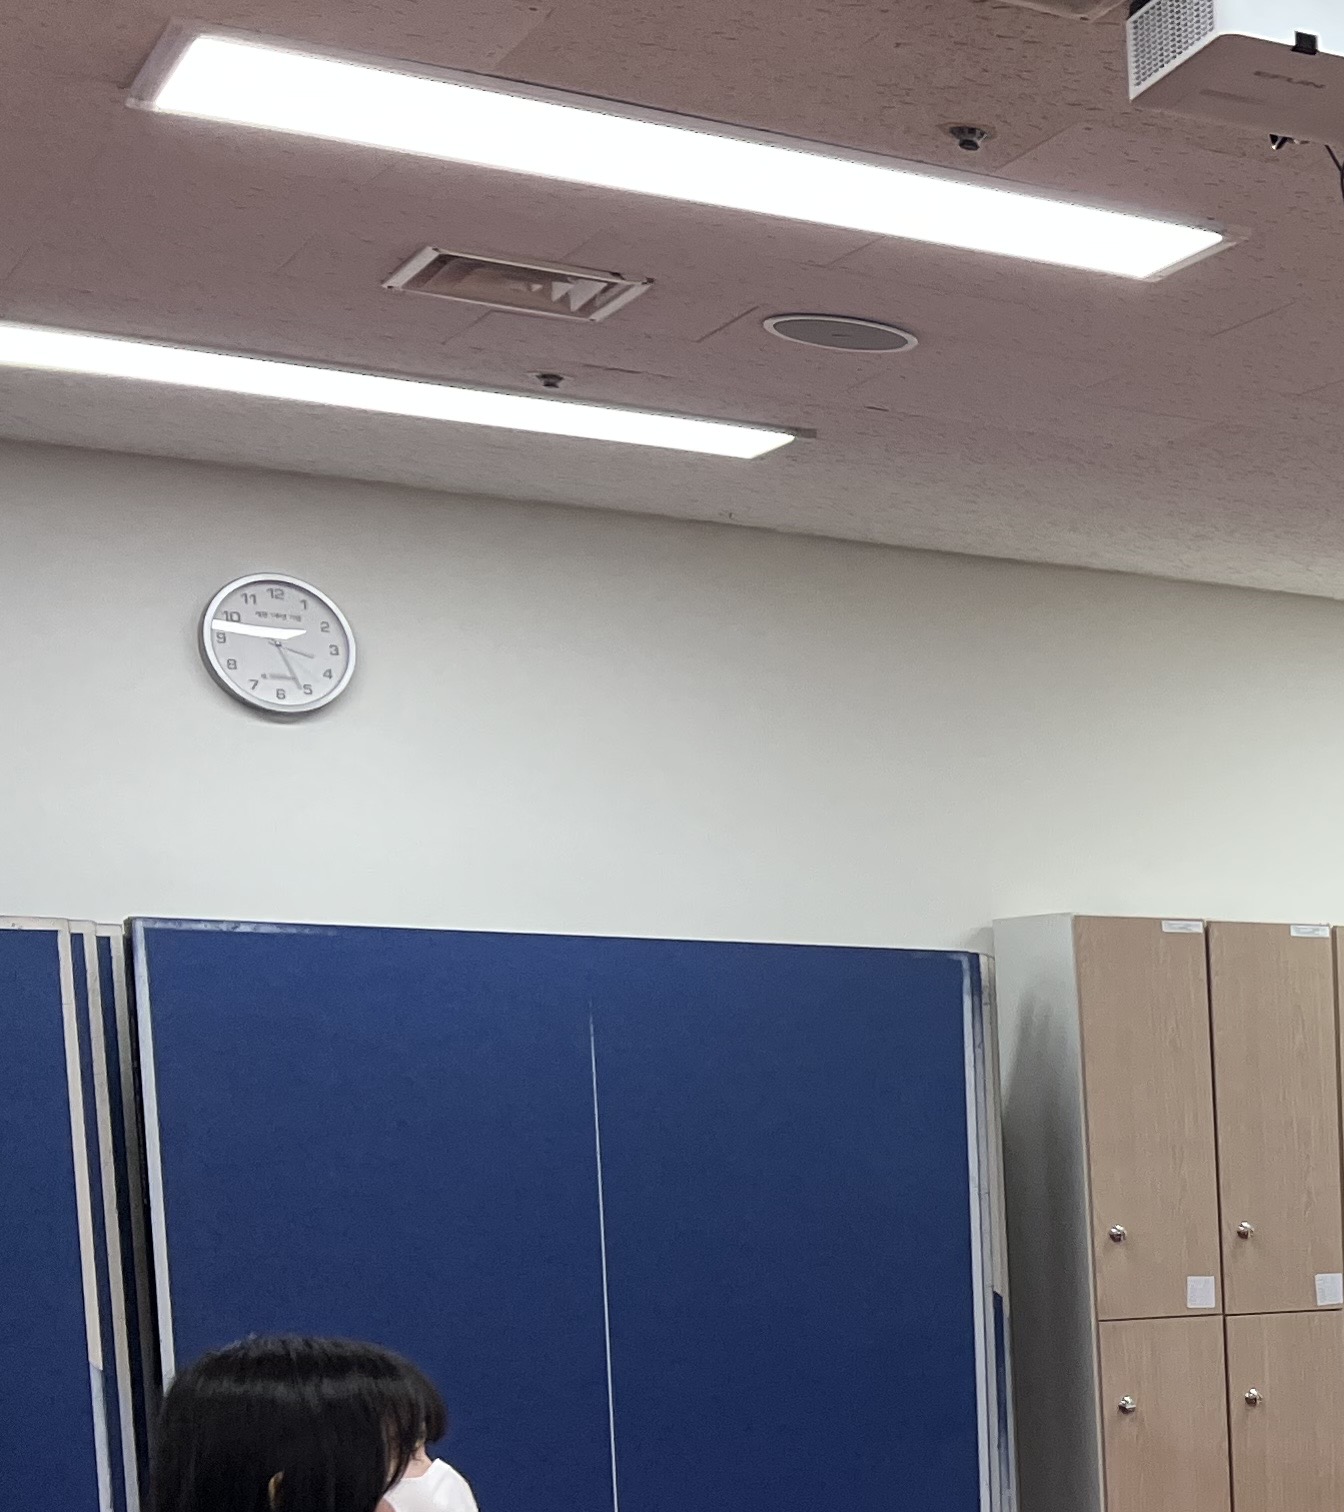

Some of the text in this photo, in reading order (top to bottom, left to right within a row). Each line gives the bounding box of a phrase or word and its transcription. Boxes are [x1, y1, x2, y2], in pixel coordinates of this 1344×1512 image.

[240, 592, 257, 605] 11
[266, 587, 285, 600] 12
[300, 599, 307, 611] 1
[222, 610, 241, 623] 10
[320, 621, 331, 633] 2
[216, 632, 226, 644] 9
[329, 644, 340, 656] 3
[226, 658, 238, 670] 8
[322, 668, 333, 680] 4
[248, 679, 259, 691] 7
[302, 683, 313, 695] 5
[275, 688, 286, 700] 6
